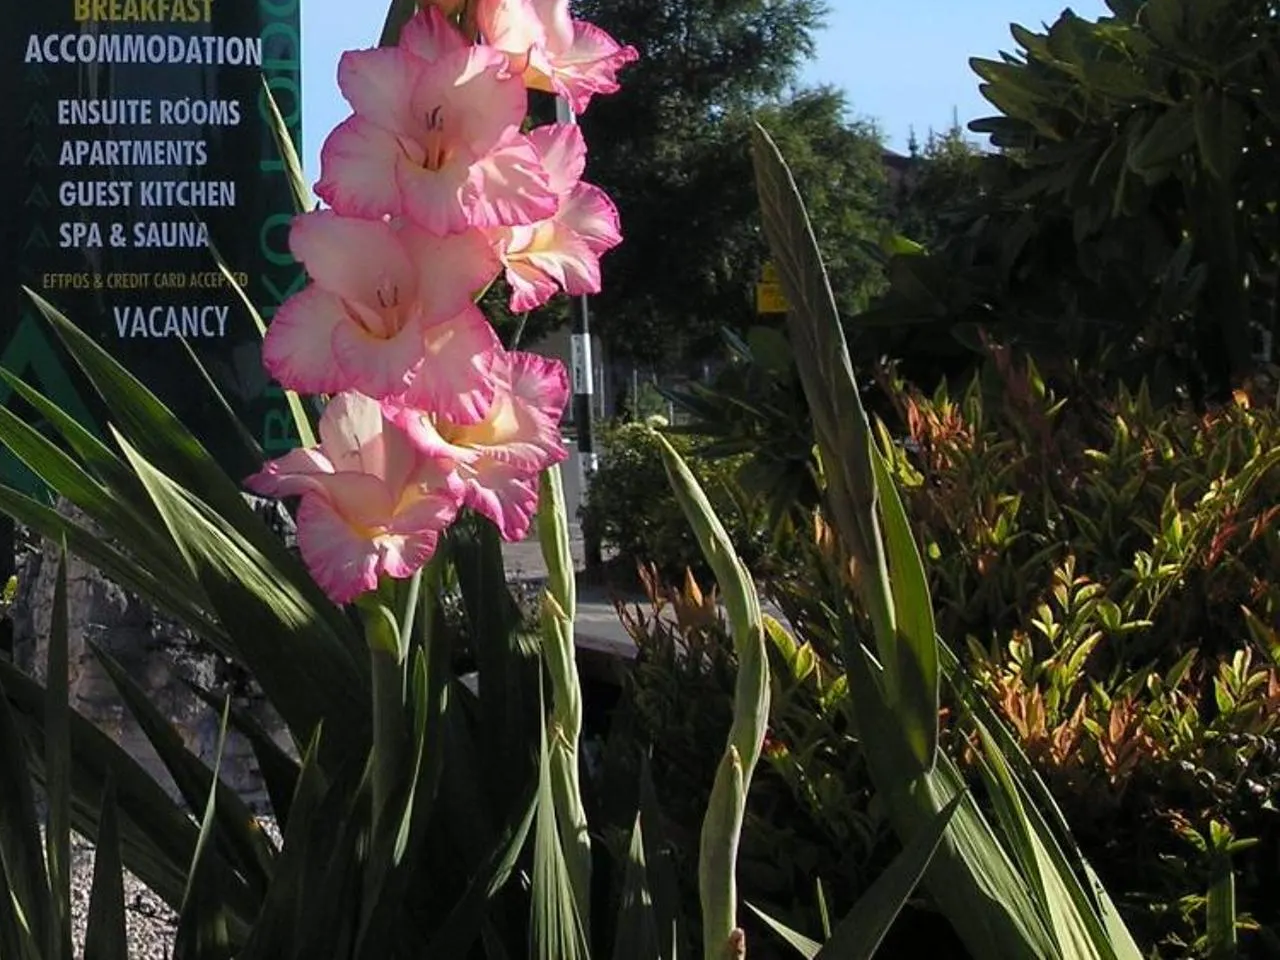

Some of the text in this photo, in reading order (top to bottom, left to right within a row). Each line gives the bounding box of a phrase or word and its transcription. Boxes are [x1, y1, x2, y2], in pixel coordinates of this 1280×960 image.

[24, 34, 262, 66] ACCOMMODATION
[57, 100, 241, 126] ENSUITE ROOMS
[58, 141, 207, 166] APARTMENTS
[58, 181, 236, 207] GUEST KITCHEN
[59, 222, 209, 248] SPA & SAUNA
[42, 271, 249, 289] EFTPOS & CREDIT CARD ACCEPED
[114, 305, 229, 338] VACANCY
